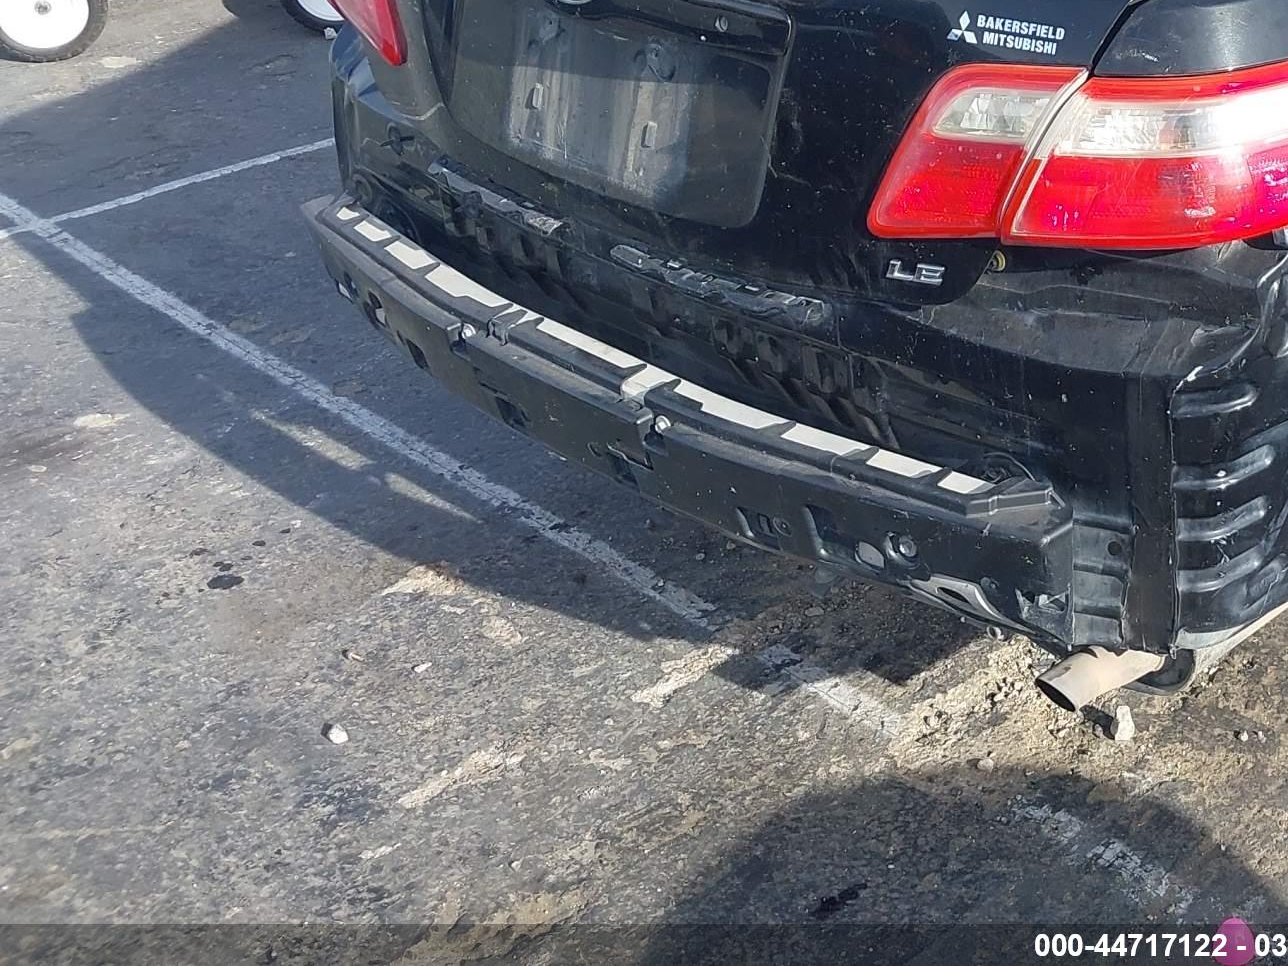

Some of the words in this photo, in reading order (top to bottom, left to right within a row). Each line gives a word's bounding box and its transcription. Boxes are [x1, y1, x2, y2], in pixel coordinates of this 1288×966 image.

[976, 14, 1066, 41] BAKERSFIELD
[982, 30, 1058, 56] MITSUBISHI
[886, 260, 946, 287] LE
